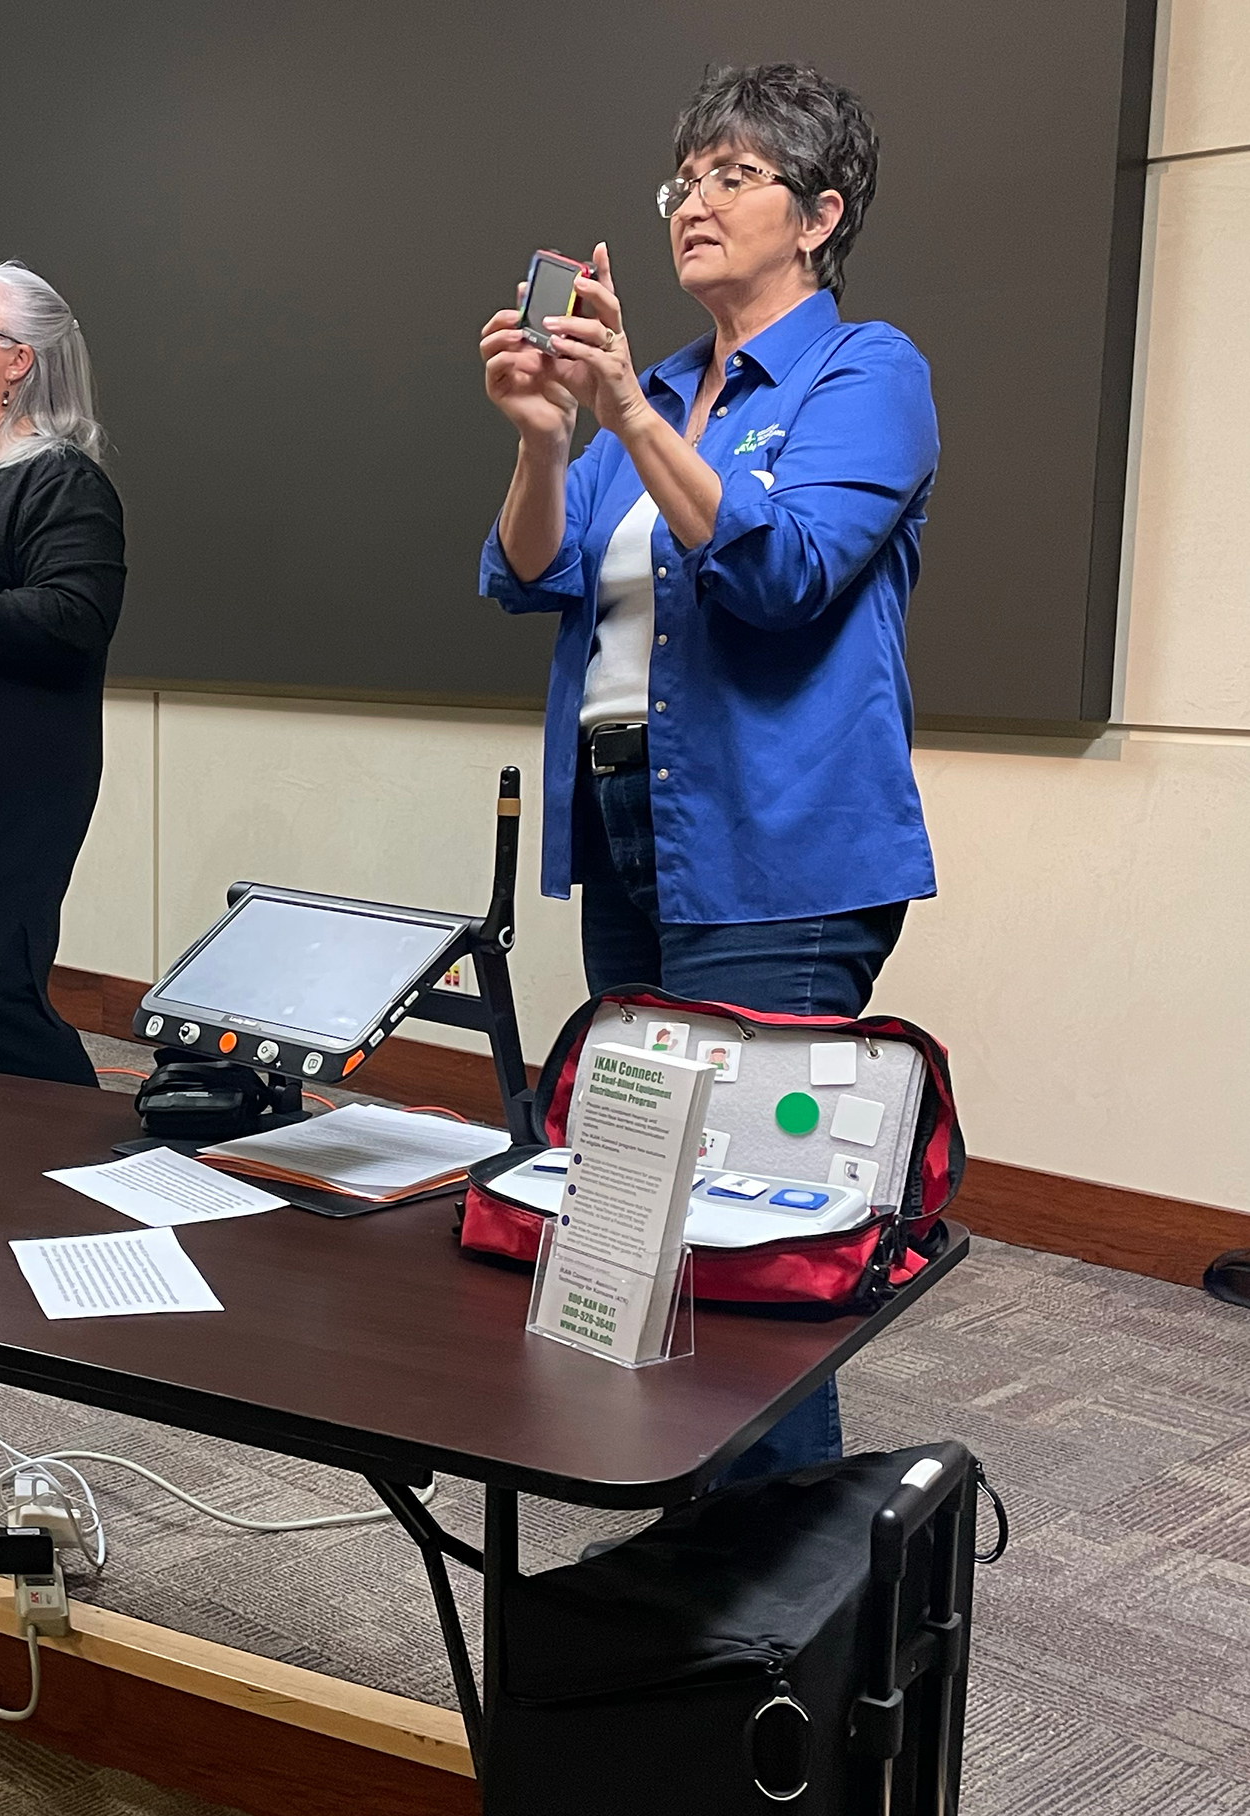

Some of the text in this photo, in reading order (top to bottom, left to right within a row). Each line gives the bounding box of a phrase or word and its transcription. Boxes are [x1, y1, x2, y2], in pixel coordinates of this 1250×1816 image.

[594, 1056, 664, 1084] iKAN Connect:
[590, 1084, 657, 1109] Distribution Program
[592, 1072, 600, 1081] KS
[636, 1083, 672, 1099] Equipment
[568, 1292, 597, 1310] 800-KAN
[608, 1307, 616, 1317] IT
